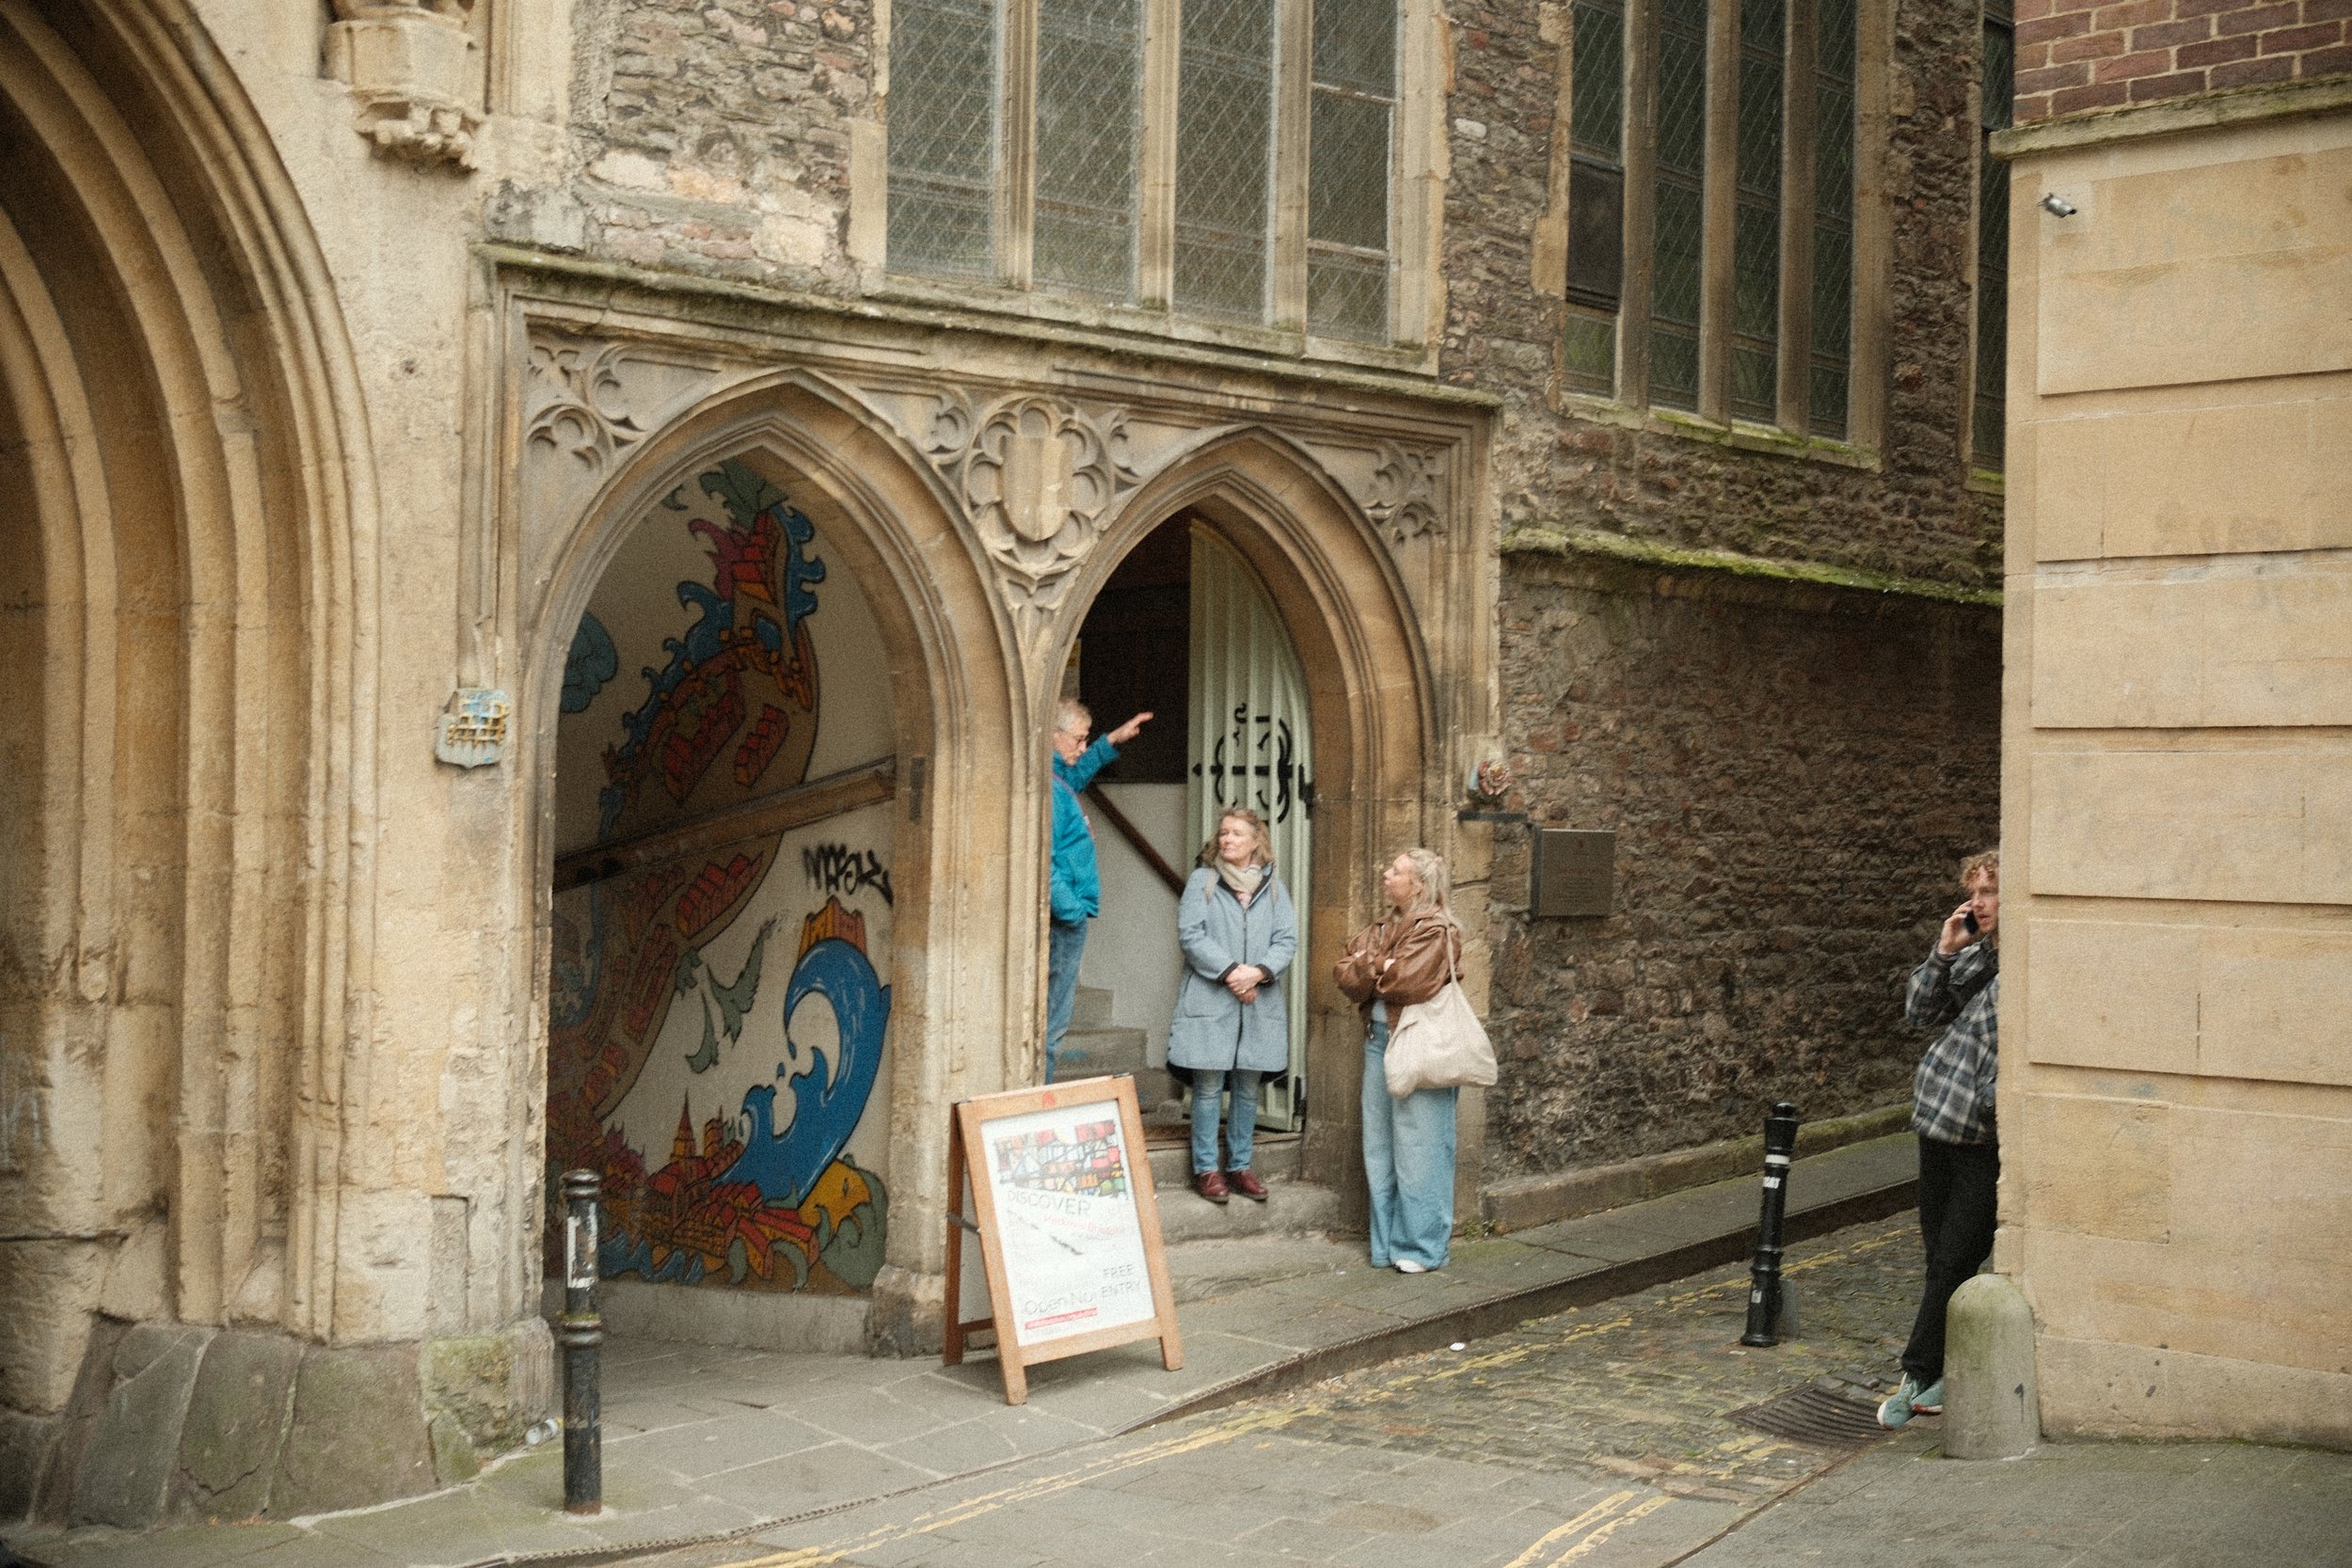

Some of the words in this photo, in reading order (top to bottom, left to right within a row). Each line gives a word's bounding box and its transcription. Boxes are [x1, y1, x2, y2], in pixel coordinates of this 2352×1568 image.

[1008, 1189, 1091, 1215] DISCOVER
[1103, 1263, 1135, 1278] FREE
[1101, 1279, 1142, 1299] ENTRY
[1024, 1295, 1067, 1316] Open
